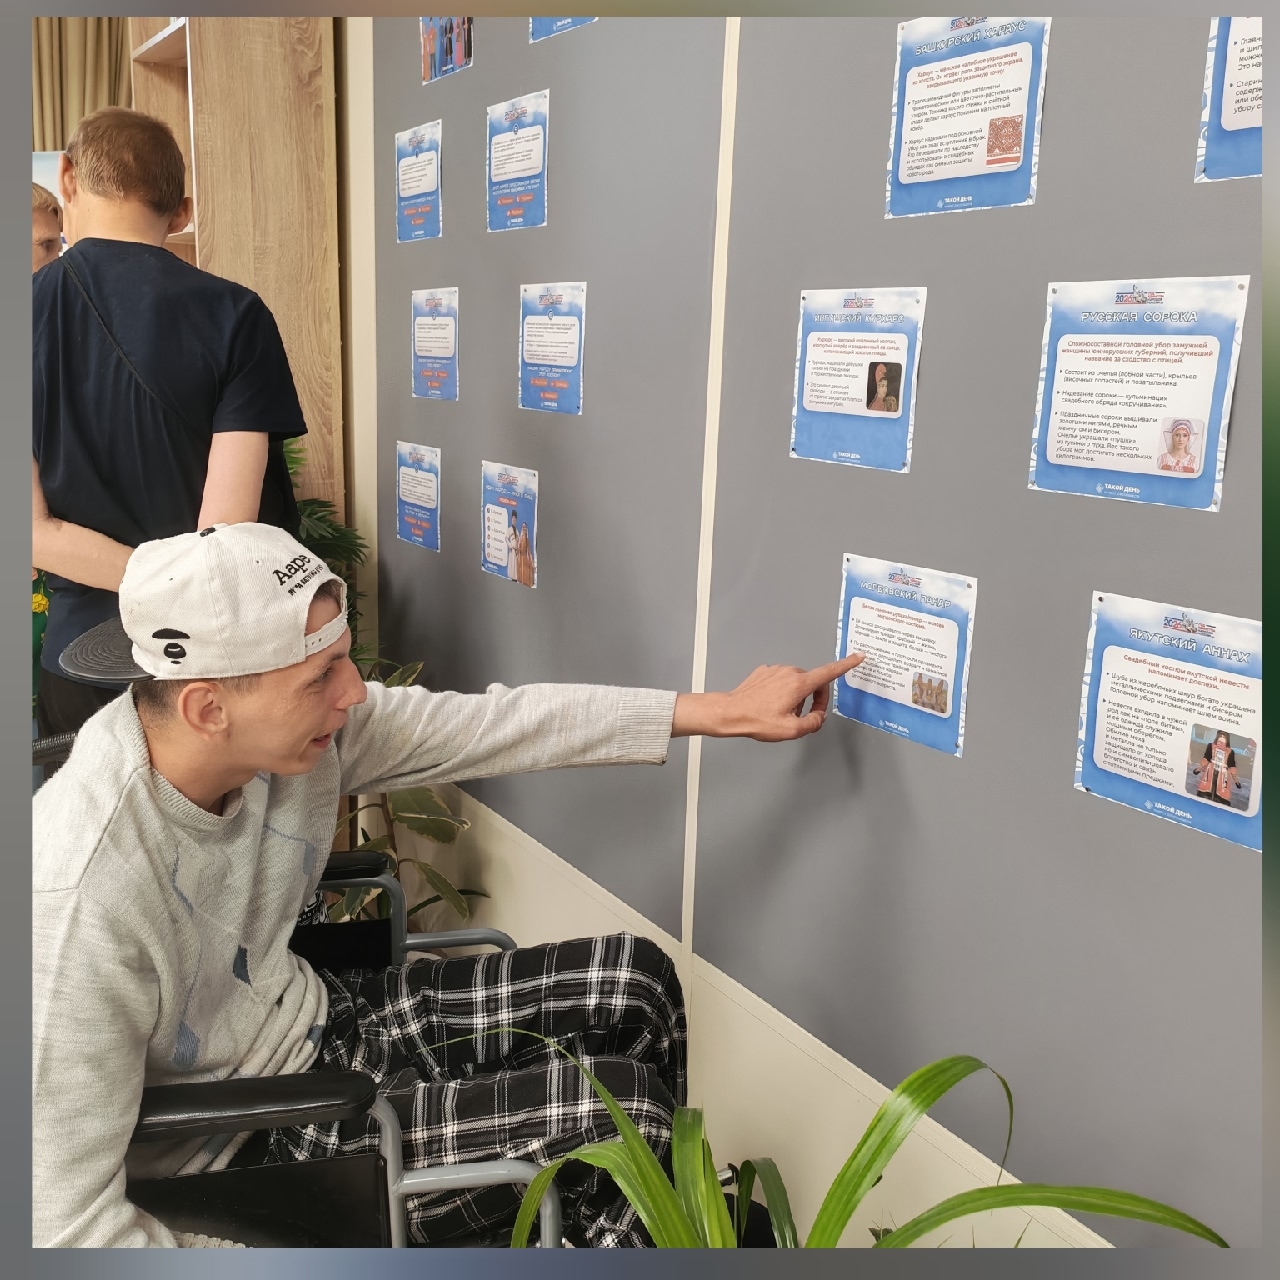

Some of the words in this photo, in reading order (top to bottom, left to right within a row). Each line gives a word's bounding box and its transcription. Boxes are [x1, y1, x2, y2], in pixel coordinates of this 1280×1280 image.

[915, 28, 980, 56] БАШКИРСКИЙ
[984, 20, 1027, 38] ХАРАУС
[1082, 311, 1138, 322] РУССКАЯ
[1143, 311, 1197, 322] СОРОКА
[1105, 483, 1123, 491] ТАКОЙ
[1124, 485, 1140, 493] ДЕНЬ
[273, 555, 310, 586] Aape
[1129, 628, 1197, 651] ЯКУТСКИЙ
[1202, 644, 1250, 663] АННАХ
[1154, 801, 1174, 813] ТАКОЙ
